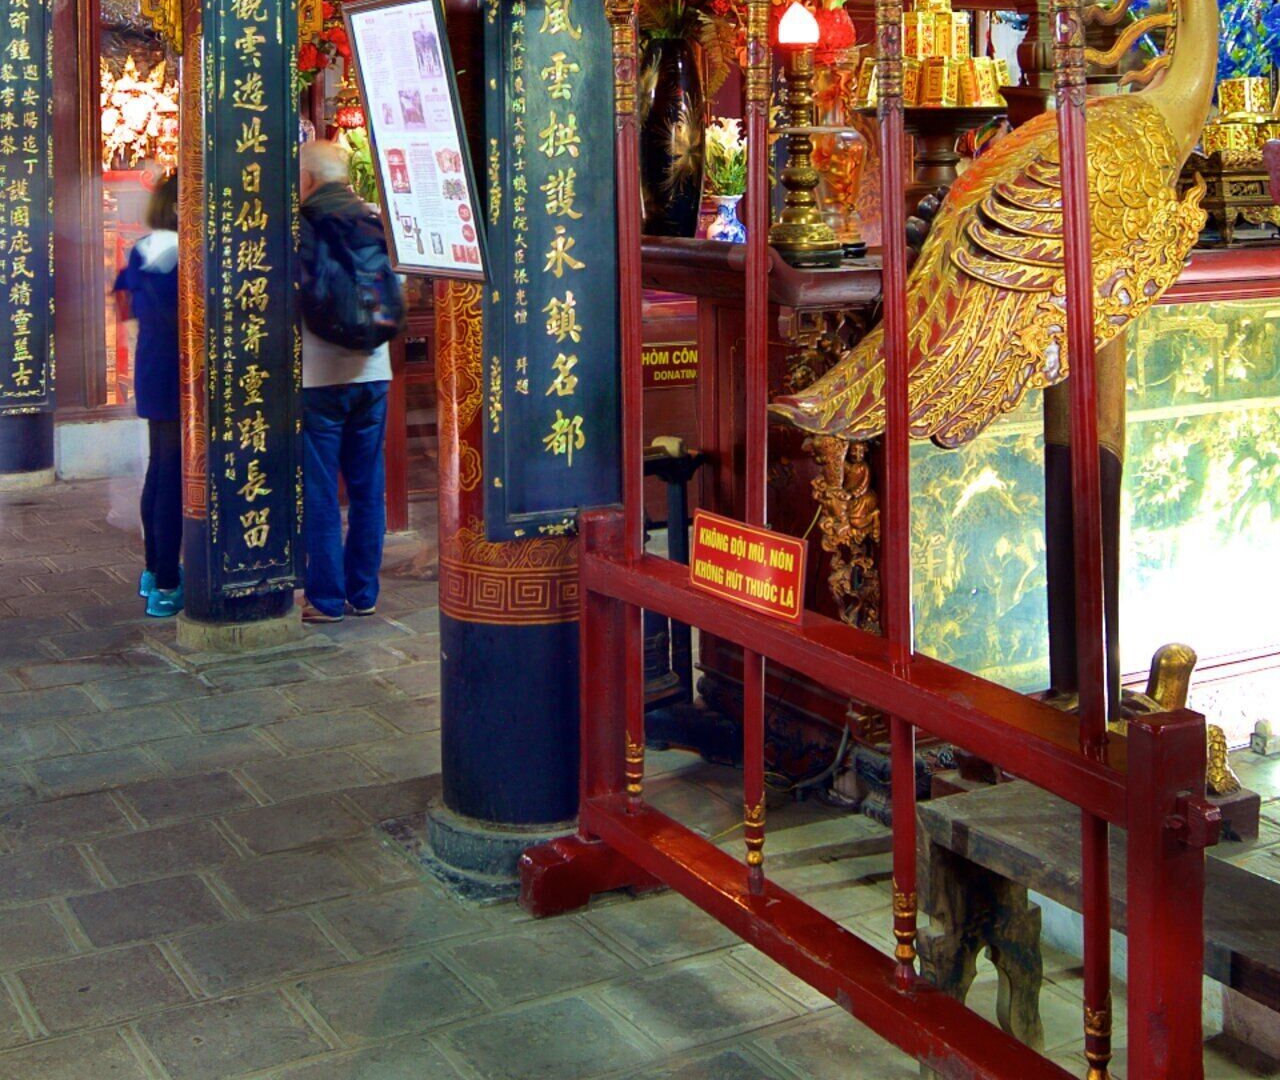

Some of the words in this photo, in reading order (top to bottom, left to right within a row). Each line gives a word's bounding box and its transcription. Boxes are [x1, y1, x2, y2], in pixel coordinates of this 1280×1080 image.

[641, 348, 669, 366] HÒM
[654, 369, 698, 381] DONATIN
[699, 527, 729, 553] KHÔNG
[730, 535, 747, 561] ĐỘI
[769, 547, 794, 573] NÓN
[694, 559, 724, 585] KHÔNG
[725, 568, 744, 592] HÚT
[745, 576, 778, 604] THUỐC
[779, 586, 795, 609] LÁ
